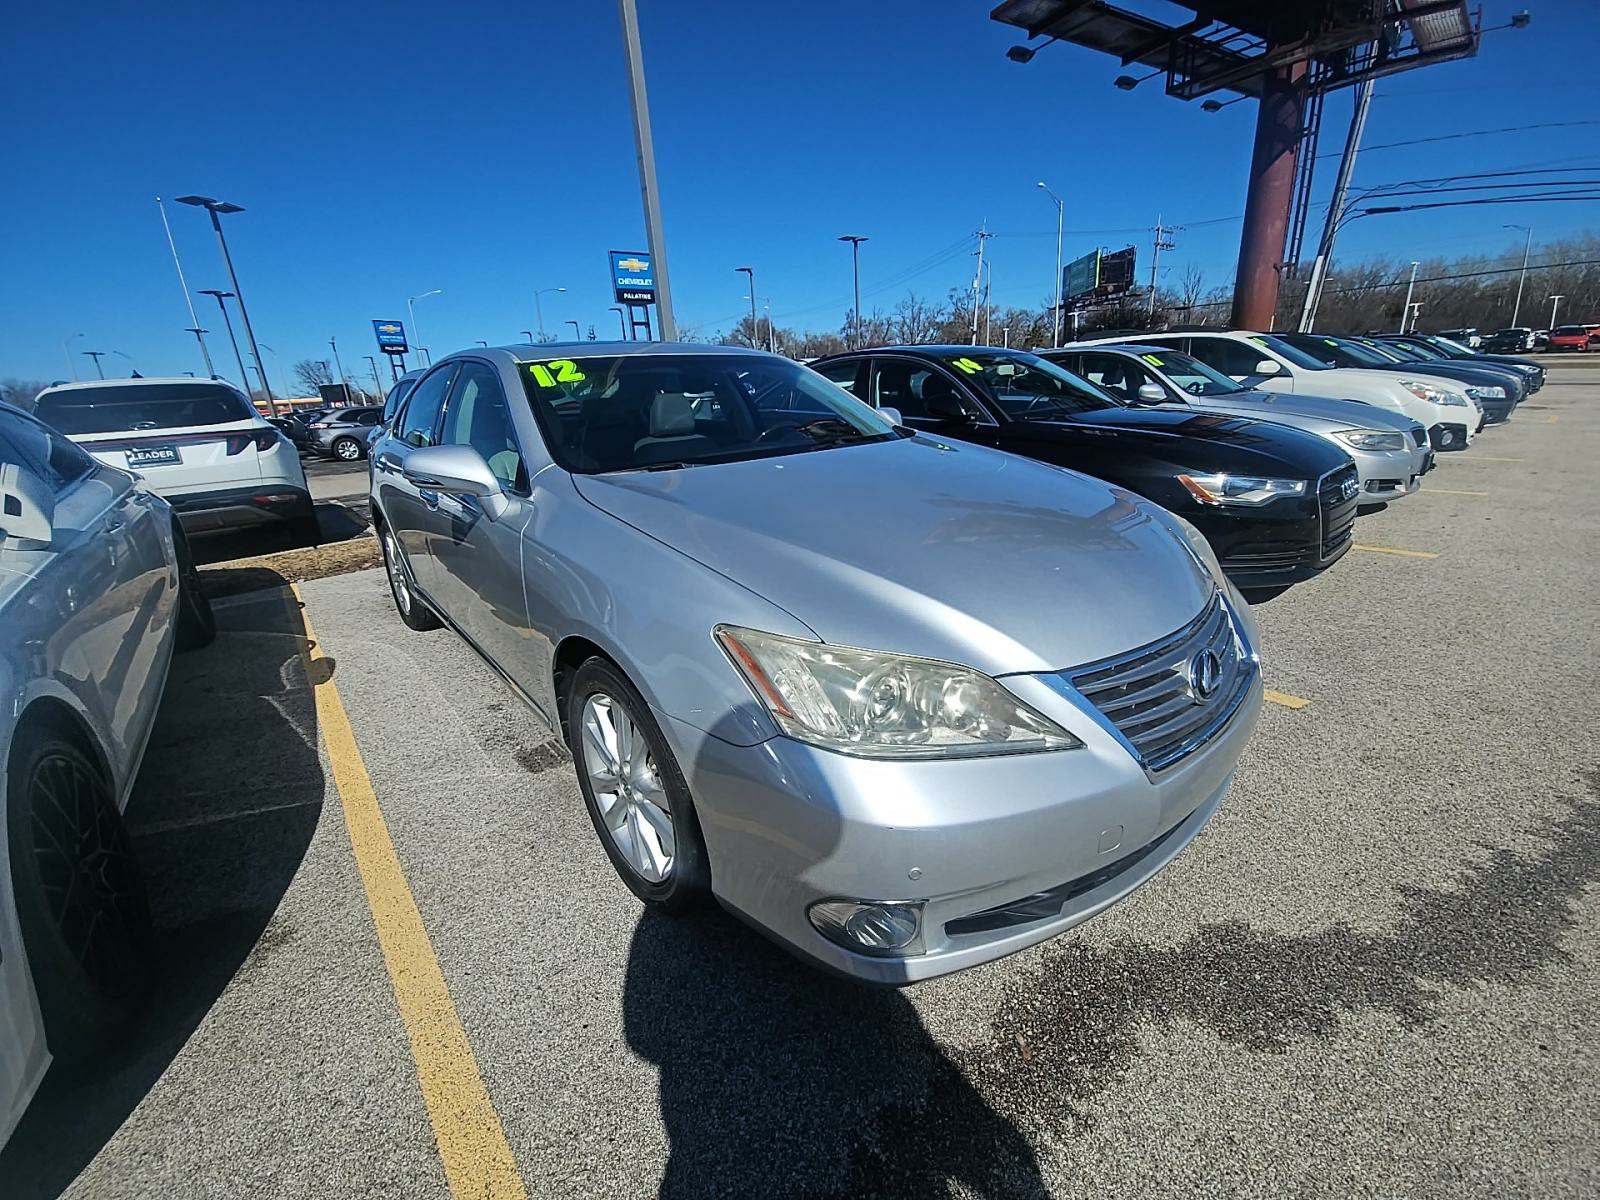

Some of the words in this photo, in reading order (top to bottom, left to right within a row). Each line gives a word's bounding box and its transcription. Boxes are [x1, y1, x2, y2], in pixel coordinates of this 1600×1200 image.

[618, 277, 652, 286] CHEVROLET
[529, 360, 586, 387] 12
[131, 450, 175, 461] LEADER
